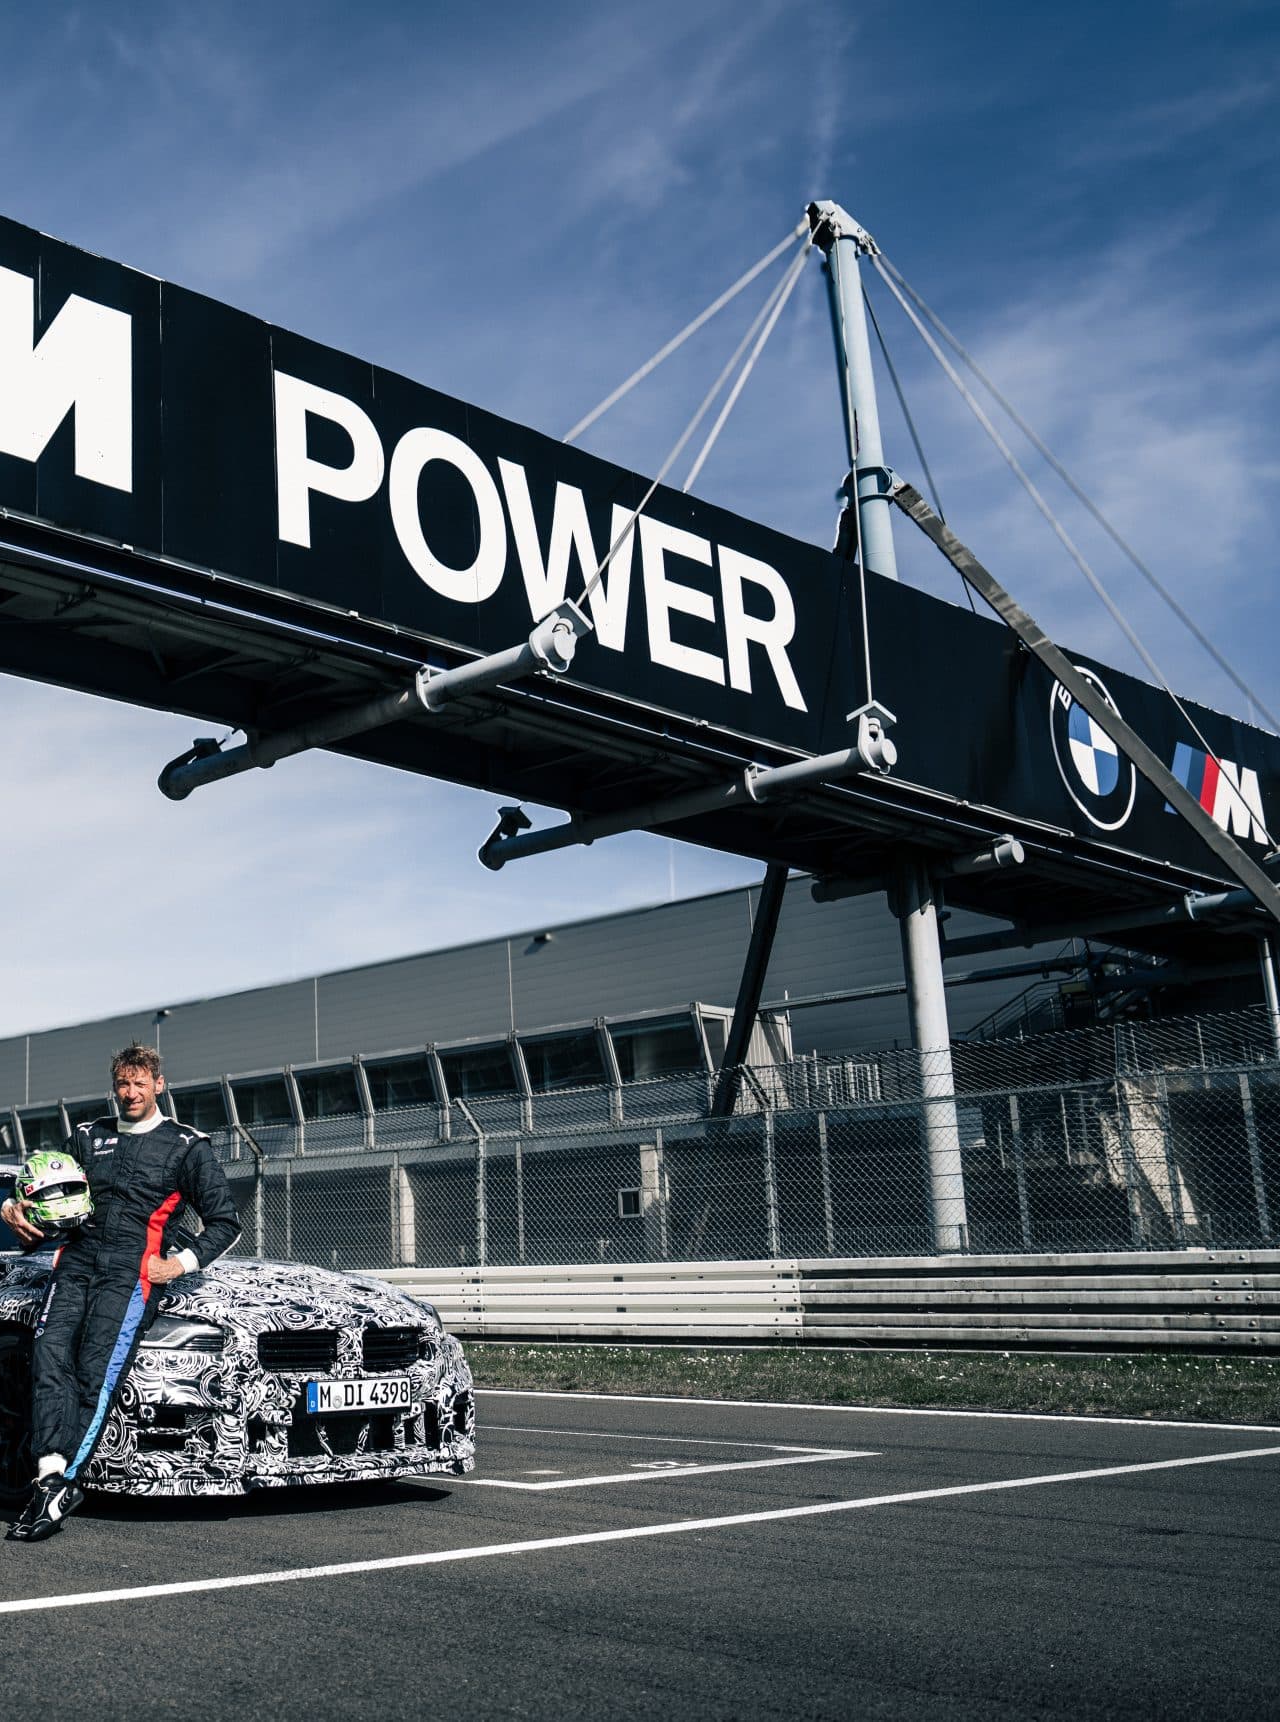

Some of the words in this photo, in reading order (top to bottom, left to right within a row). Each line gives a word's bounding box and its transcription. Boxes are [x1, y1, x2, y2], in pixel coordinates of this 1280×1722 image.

[273, 369, 808, 713] POWER
[320, 1385, 331, 1408] M
[344, 1384, 365, 1406] DI
[370, 1381, 409, 1405] 4398
